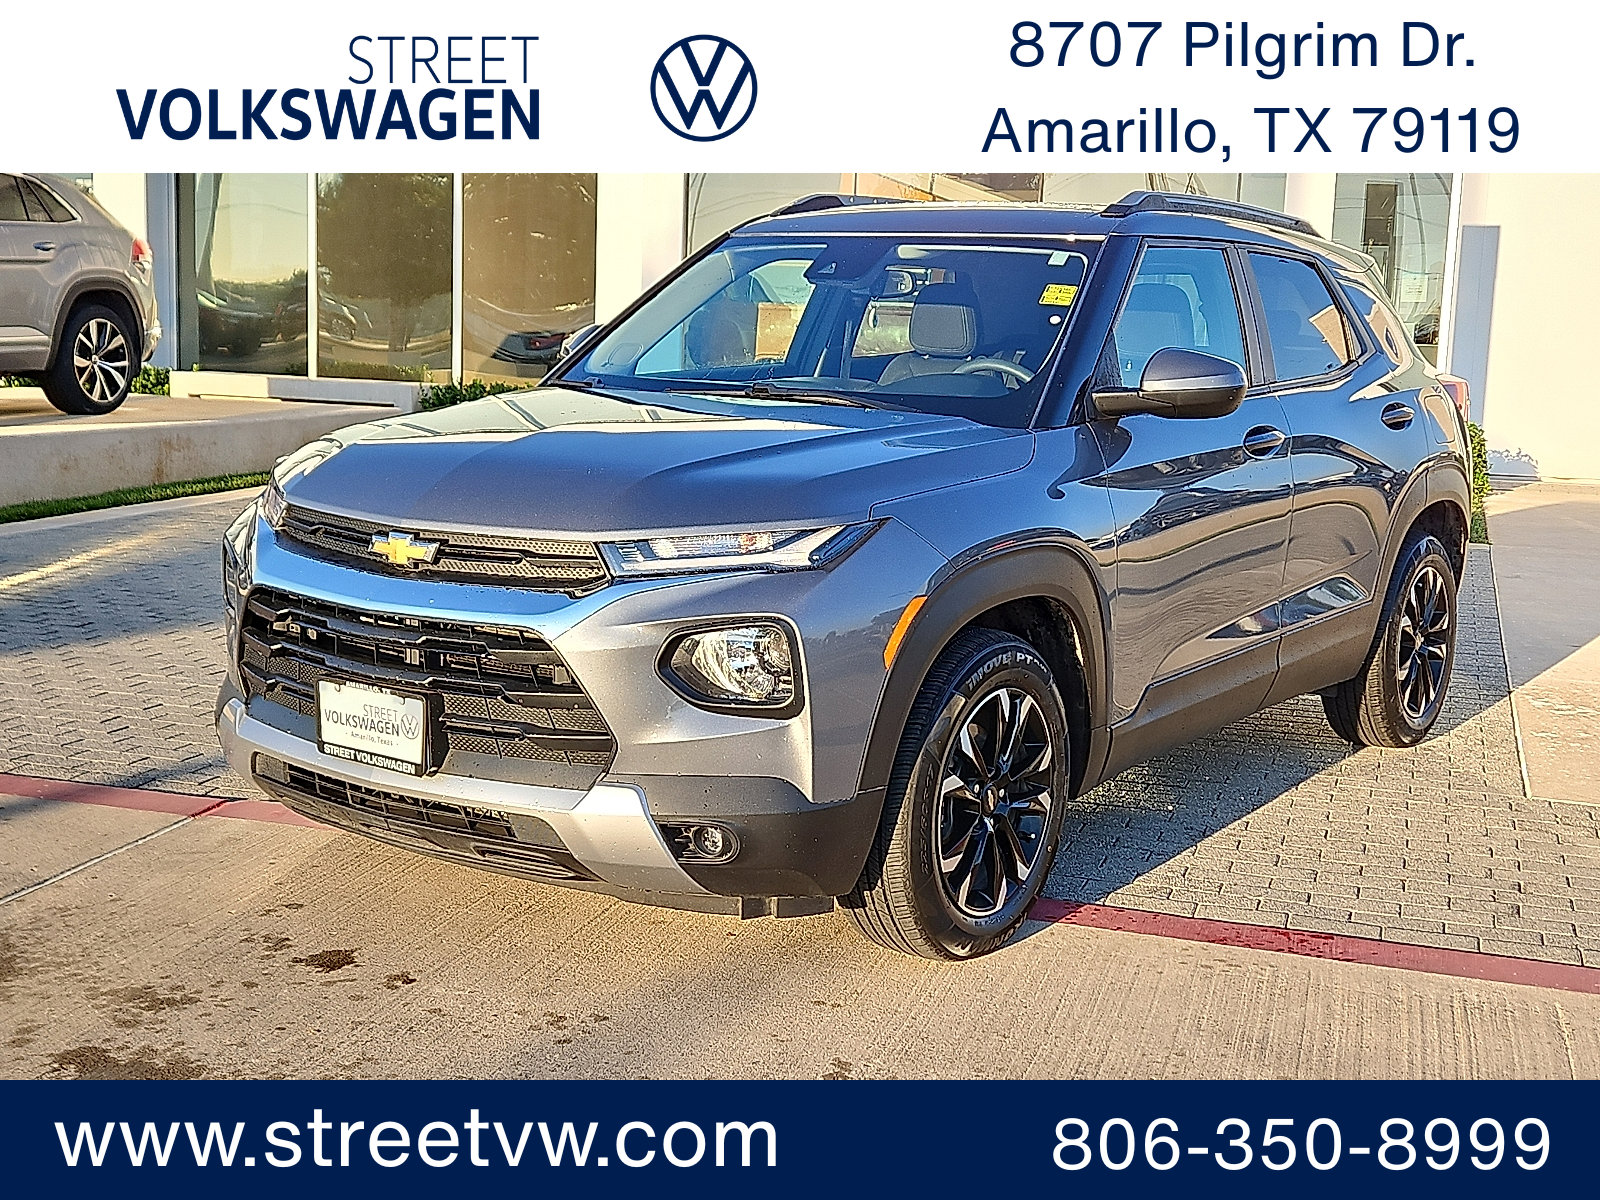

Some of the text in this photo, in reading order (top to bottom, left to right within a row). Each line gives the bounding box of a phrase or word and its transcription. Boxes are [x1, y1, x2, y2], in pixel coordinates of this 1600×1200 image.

[324, 708, 400, 737] VOLKSWAGEN
[363, 704, 398, 722] STREET
[323, 743, 416, 775] STREET VOLKSWAGEN
